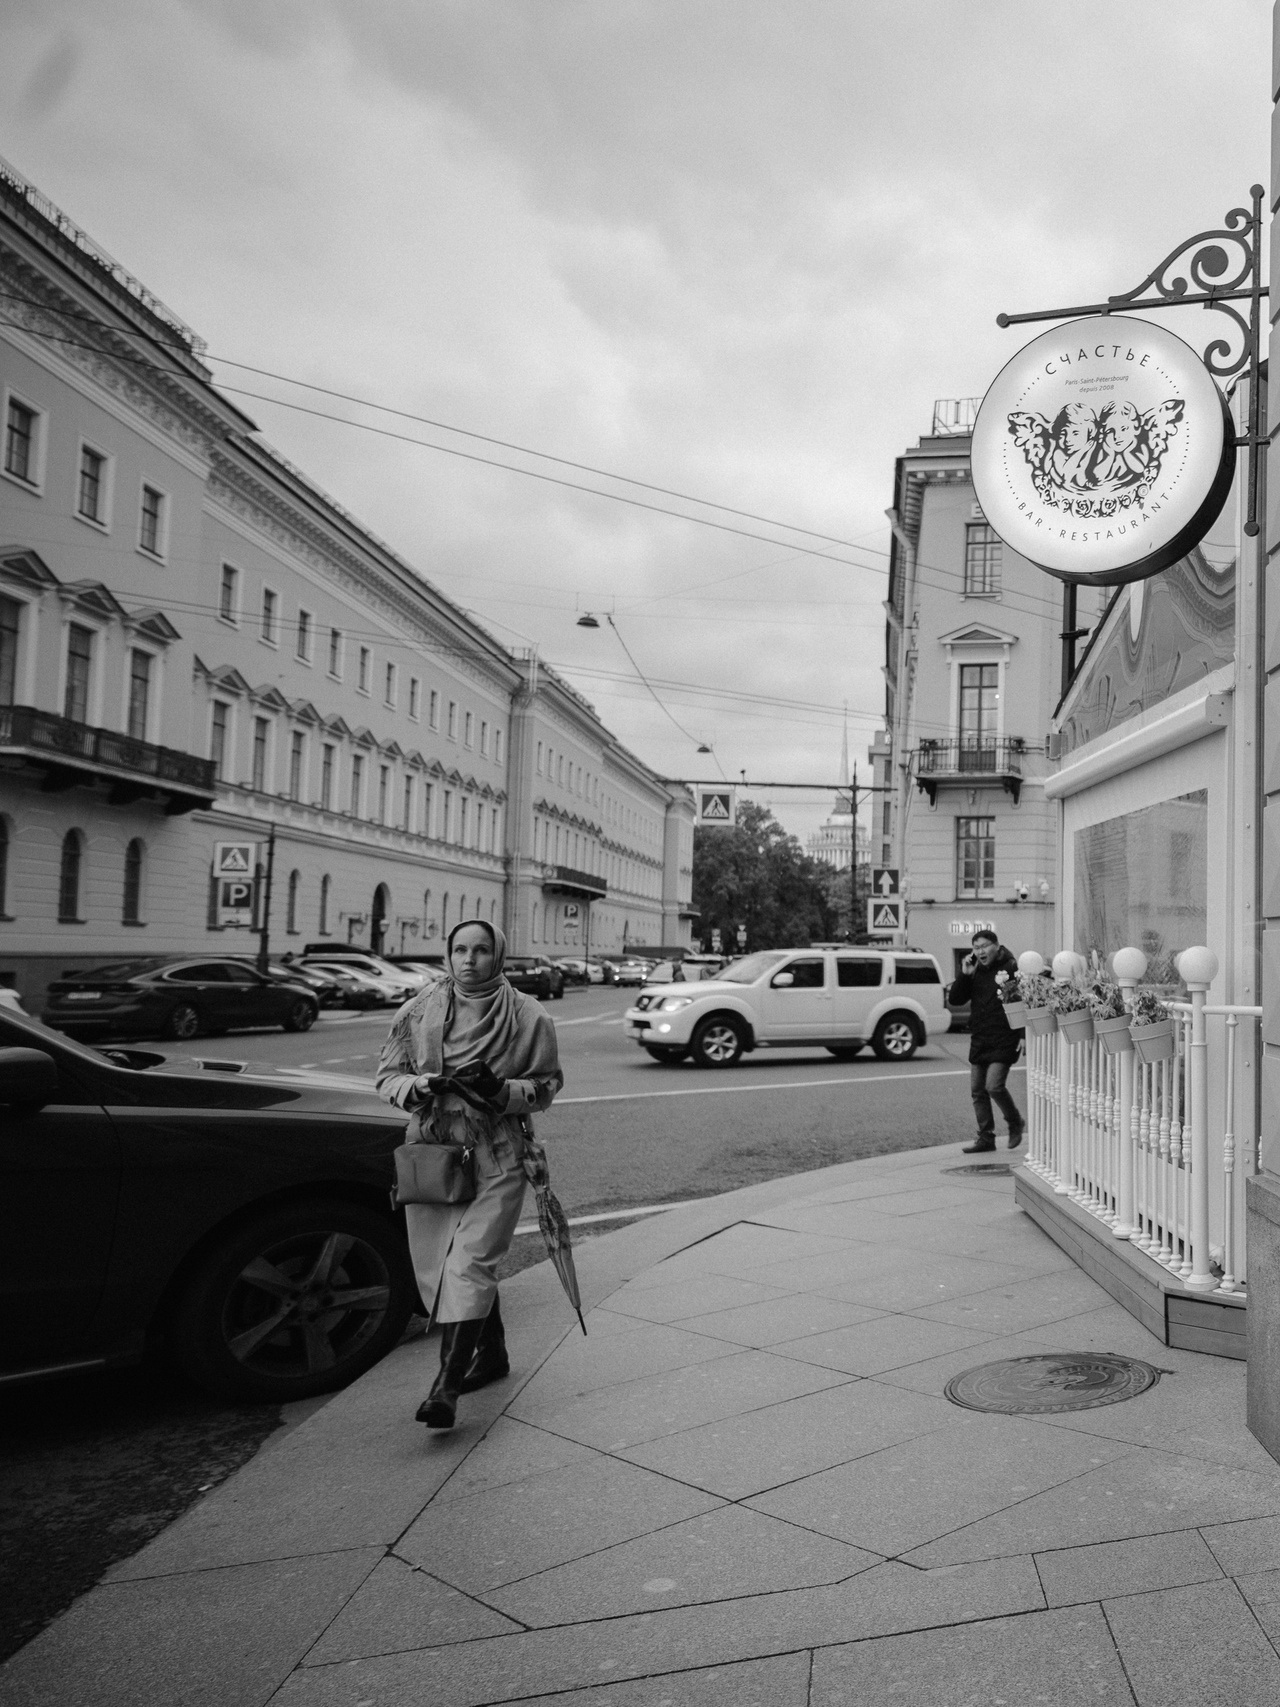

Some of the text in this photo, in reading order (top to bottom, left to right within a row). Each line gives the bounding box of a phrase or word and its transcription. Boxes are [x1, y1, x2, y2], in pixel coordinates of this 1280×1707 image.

[1045, 345, 1151, 375] СЧАСТЬЕ
[1078, 384, 1115, 393] depuis 2008
[1018, 492, 1170, 542] BAR RESTAURANT
[229, 884, 249, 906] P
[567, 904, 577, 917] P
